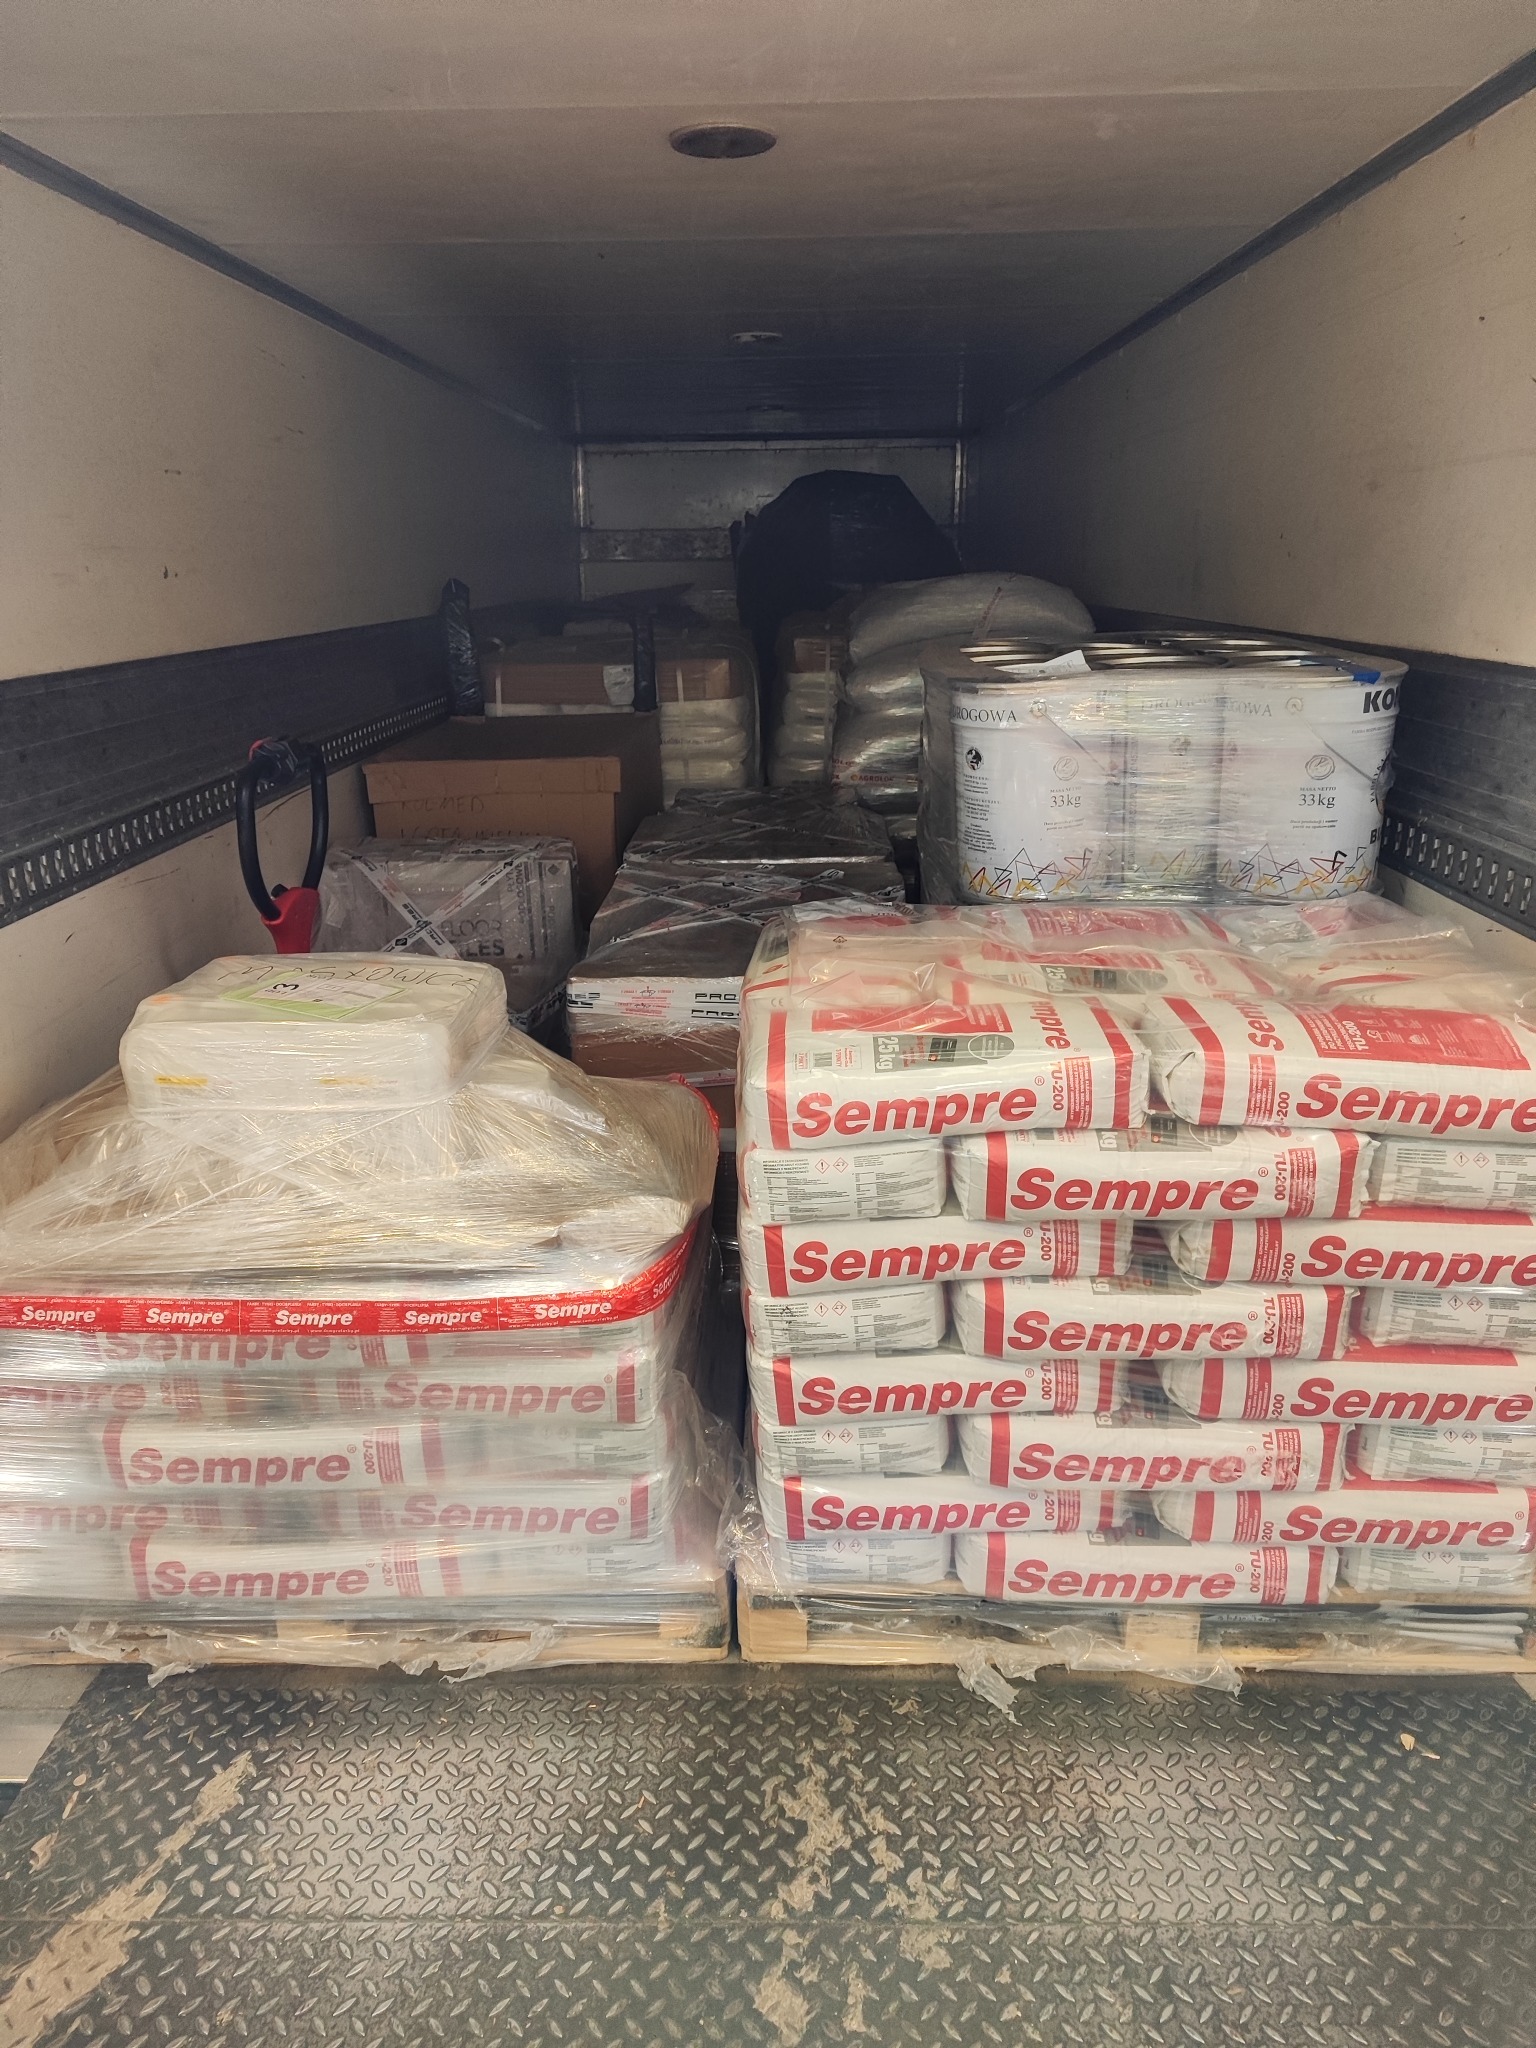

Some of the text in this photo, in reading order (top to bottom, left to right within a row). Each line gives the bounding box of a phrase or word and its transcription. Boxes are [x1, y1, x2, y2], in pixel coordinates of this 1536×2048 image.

[1342, 1020, 1369, 1050] TU-200
[1050, 1061, 1064, 1111] TU-200
[1296, 1073, 1536, 1135] Sempre
[792, 1088, 1037, 1138] Sempre
[1010, 1167, 1259, 1217] Sempre
[1273, 1152, 1287, 1201] TU-200
[790, 1239, 1026, 1283] Sempre
[1301, 1236, 1536, 1290] Sempre
[21, 1306, 96, 1324] Sempre
[145, 1307, 224, 1327] Sempre
[275, 1309, 353, 1328] Sempre
[404, 1310, 482, 1326] Sempre
[534, 1302, 612, 1319] Sempre
[102, 1334, 331, 1367] Sempre
[1008, 1311, 1248, 1357] Sempre
[384, 1372, 606, 1418] Sempre
[798, 1377, 1027, 1415] Sempre
[1290, 1378, 1533, 1425] Sempre
[128, 1448, 350, 1487] Sempre
[1013, 1443, 1246, 1490] Sempre
[401, 1494, 618, 1536] Sempre
[807, 1495, 1031, 1534] Sempre
[1279, 1505, 1514, 1550] Sempre
[152, 1561, 369, 1600] Sempre
[1008, 1559, 1236, 1605] Sempre
[1249, 1550, 1260, 1593] TU-200
